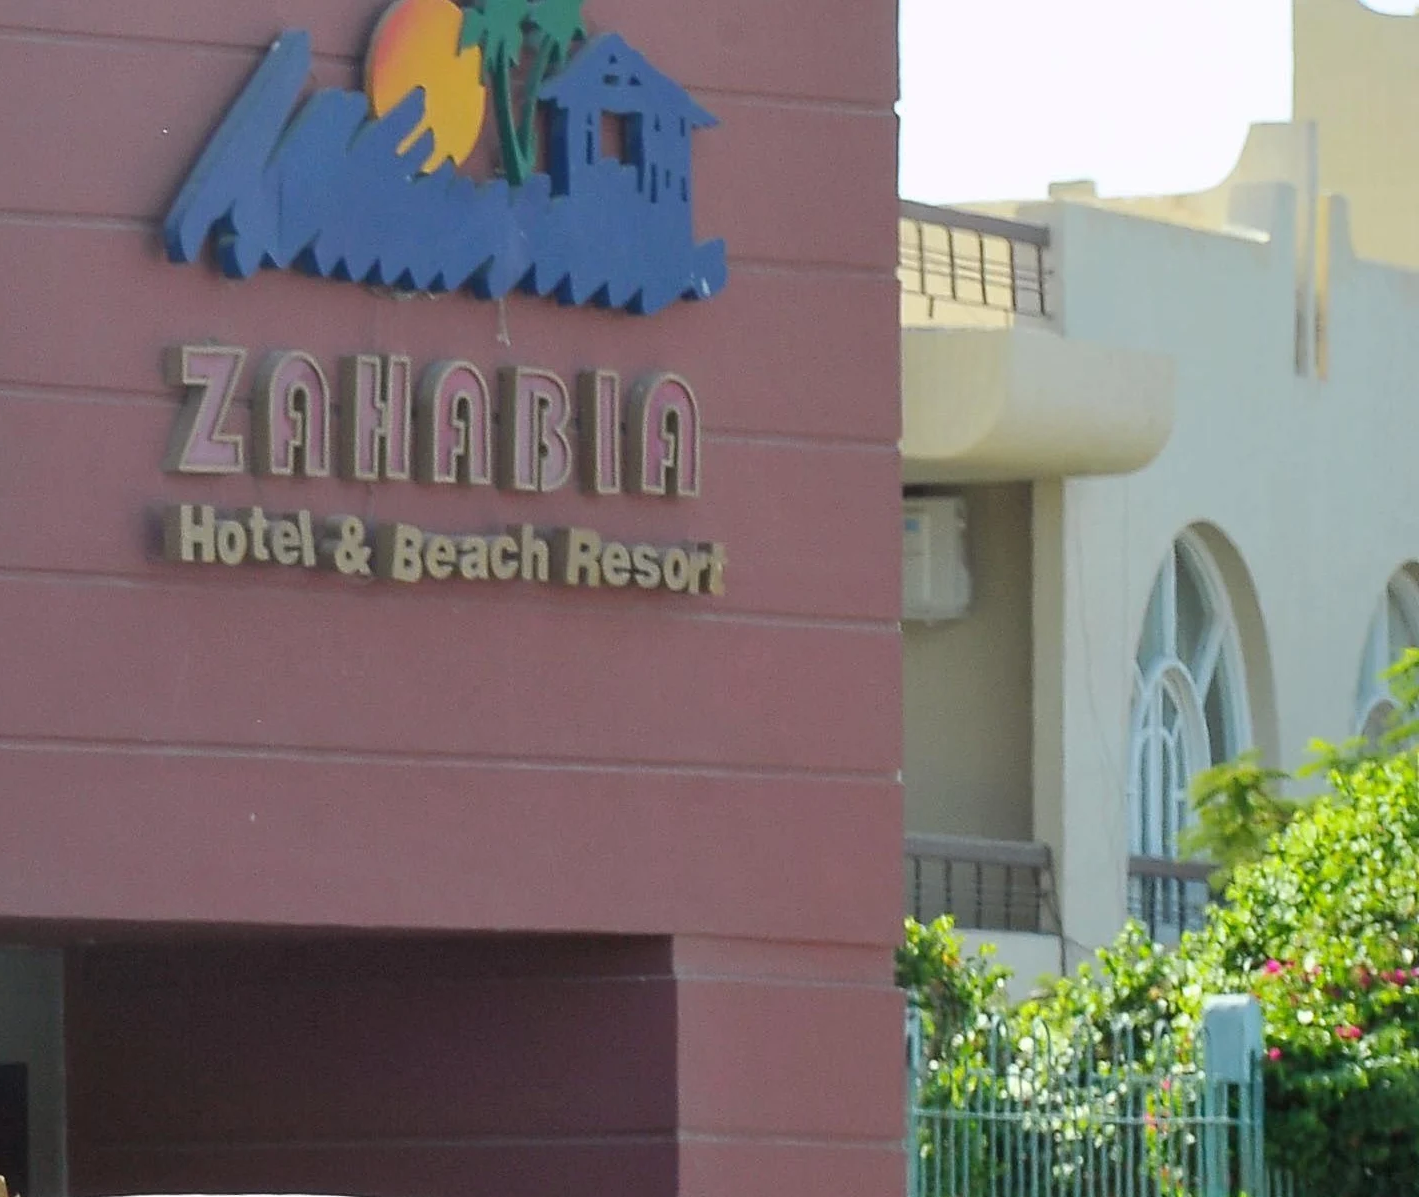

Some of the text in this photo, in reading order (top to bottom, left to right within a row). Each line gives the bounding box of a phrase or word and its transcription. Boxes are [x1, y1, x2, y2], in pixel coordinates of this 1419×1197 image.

[171, 345, 702, 498] ZAHABIA
[180, 503, 727, 596] Hotel & Beach Resort
